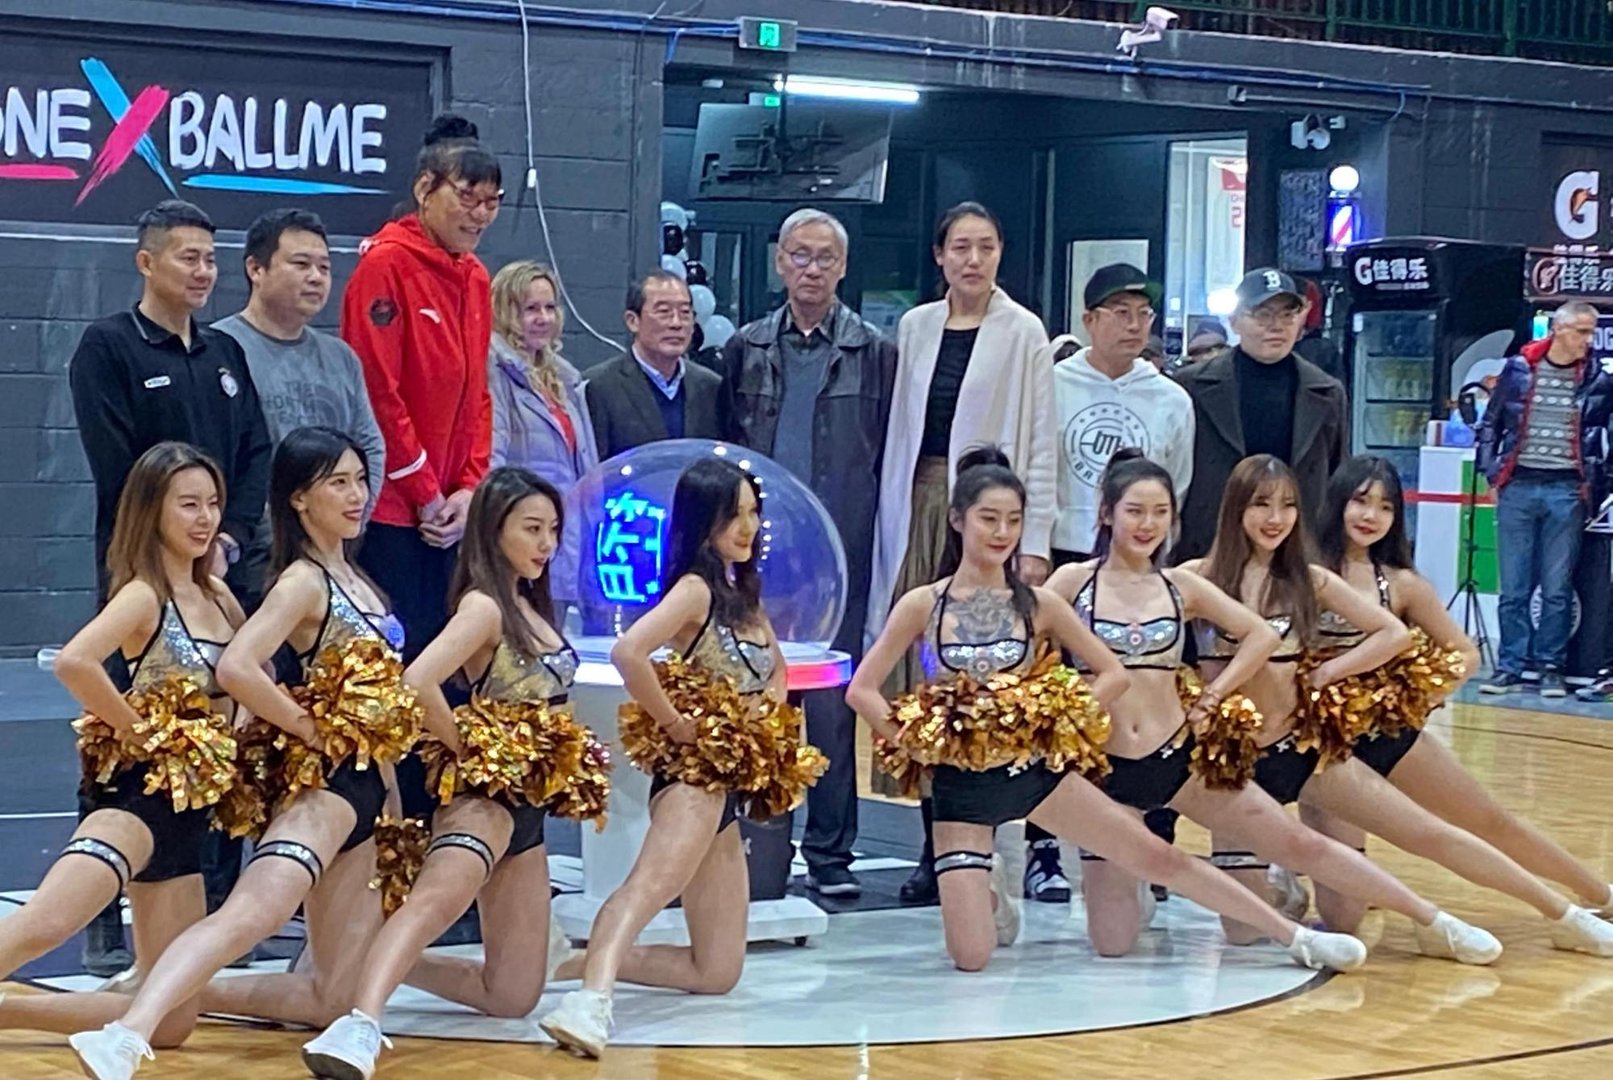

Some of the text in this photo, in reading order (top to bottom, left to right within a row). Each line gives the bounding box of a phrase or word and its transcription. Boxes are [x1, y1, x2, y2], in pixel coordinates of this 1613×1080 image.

[0, 87, 92, 160] NE
[169, 91, 387, 175] BALLME
[1555, 170, 1600, 240] G
[1263, 270, 1281, 289] B
